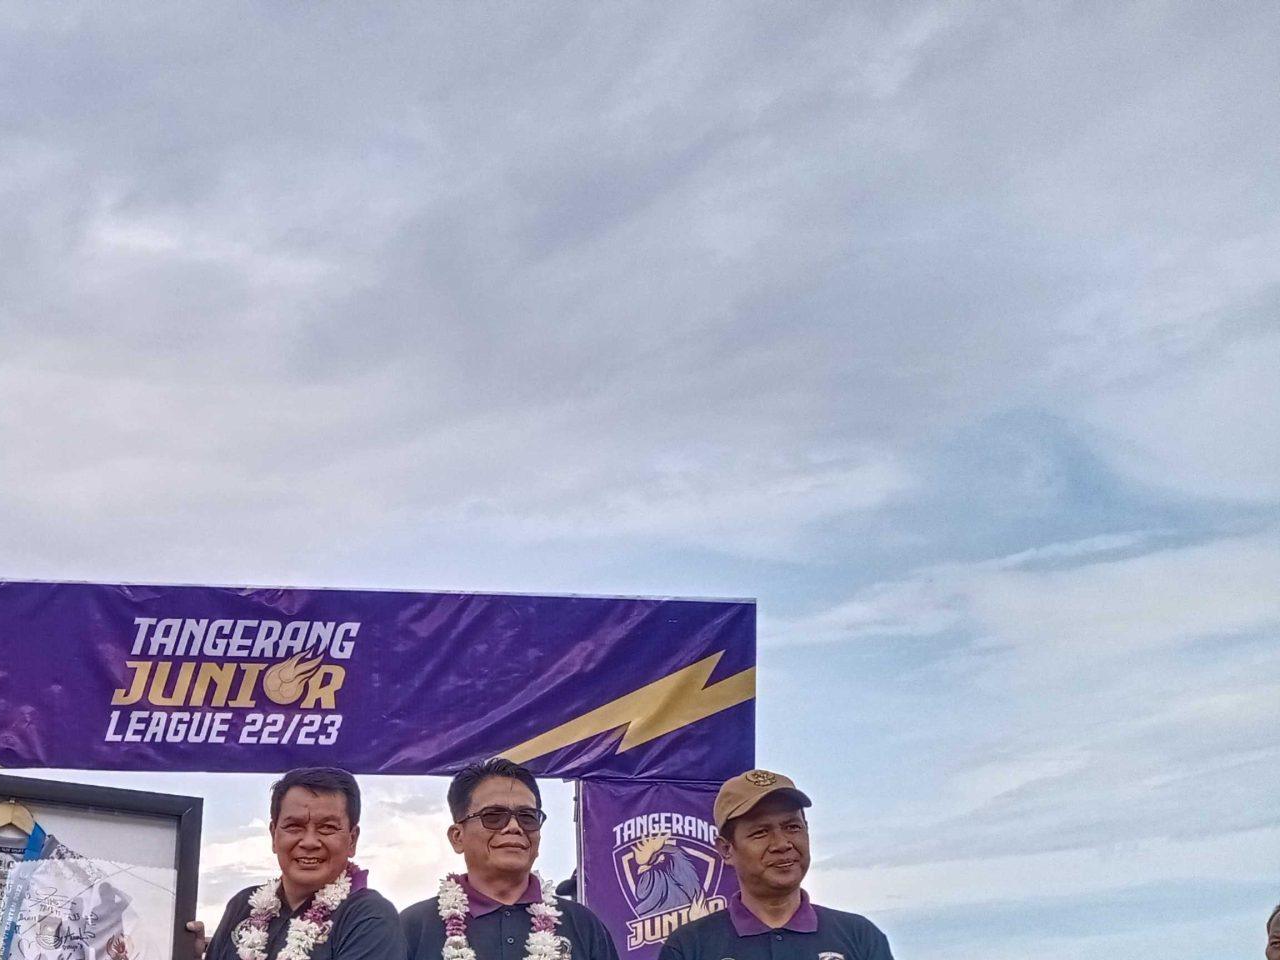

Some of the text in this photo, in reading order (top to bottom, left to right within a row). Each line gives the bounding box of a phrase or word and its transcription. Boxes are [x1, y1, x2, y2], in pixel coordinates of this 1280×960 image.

[130, 617, 361, 659] TANGERANG
[110, 660, 346, 709] JUNIOR
[104, 710, 343, 745] LEAGUE 22/23
